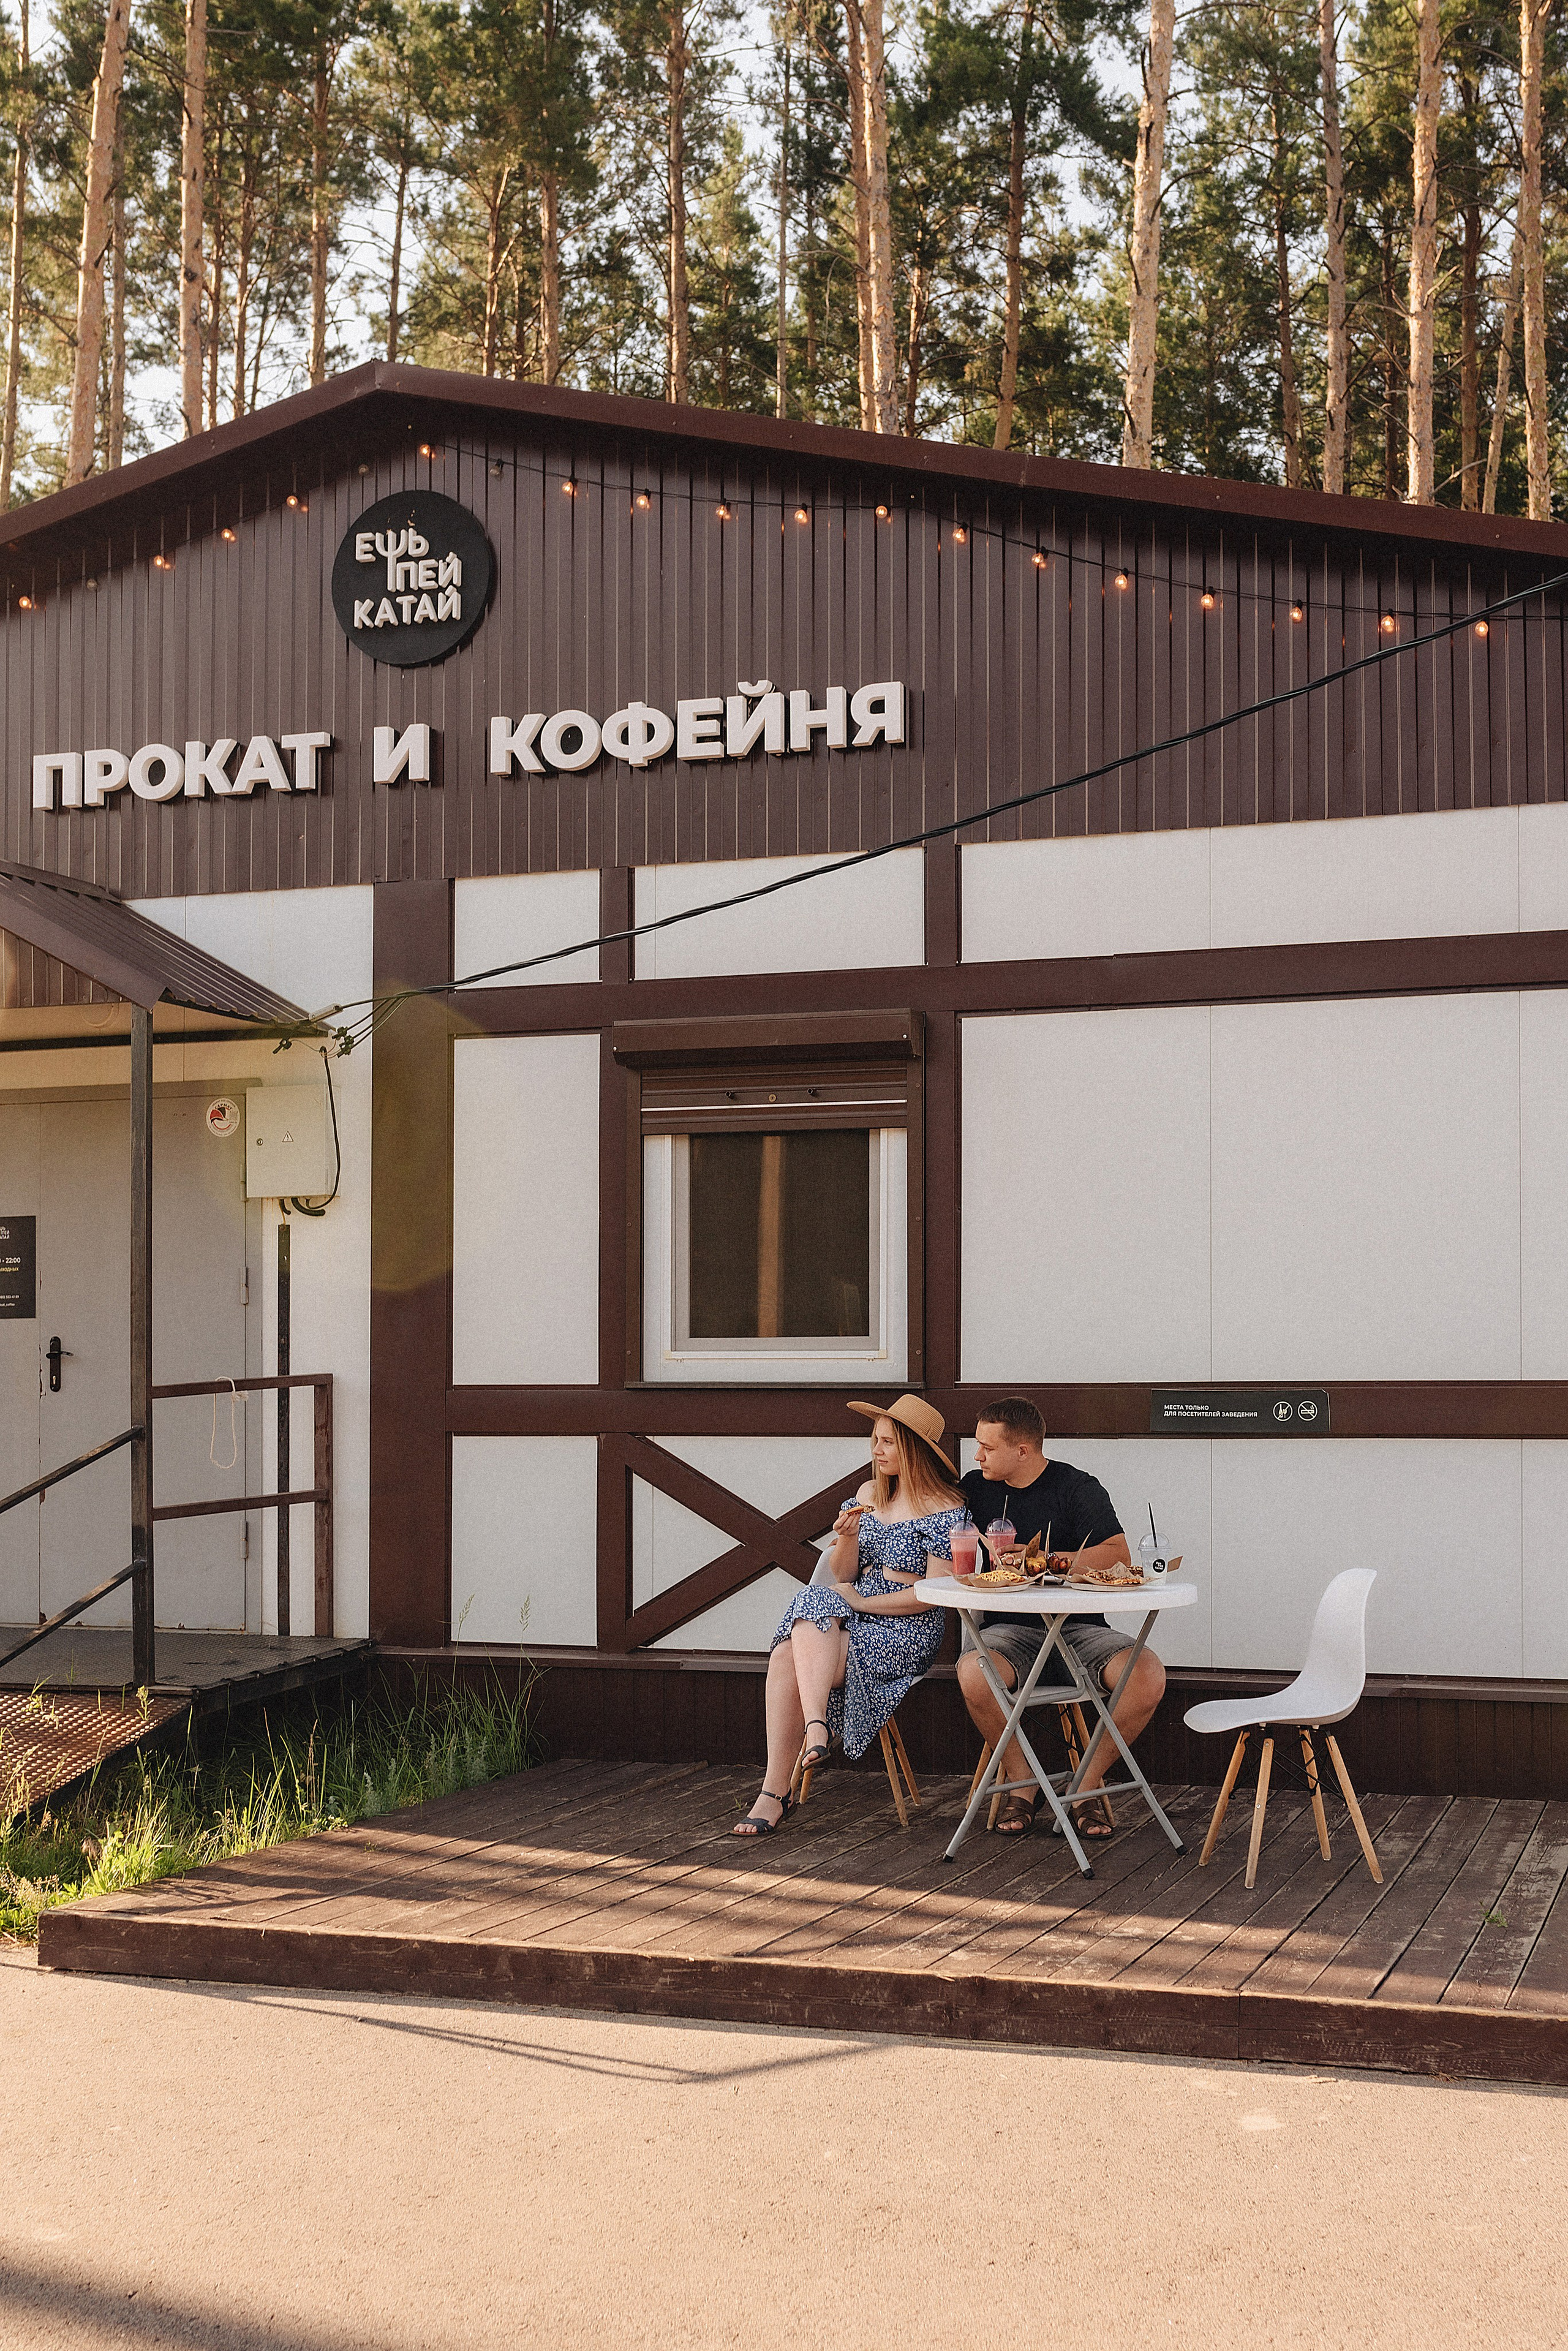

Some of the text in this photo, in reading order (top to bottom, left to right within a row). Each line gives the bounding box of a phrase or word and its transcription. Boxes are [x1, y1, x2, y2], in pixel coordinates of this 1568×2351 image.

[355, 527, 429, 592] ЕШЬ
[396, 551, 462, 592] ПЕЙ
[354, 585, 461, 629] КАТАЙ
[33, 679, 905, 811] ПРОКАТ И КОФЕЙНЯ
